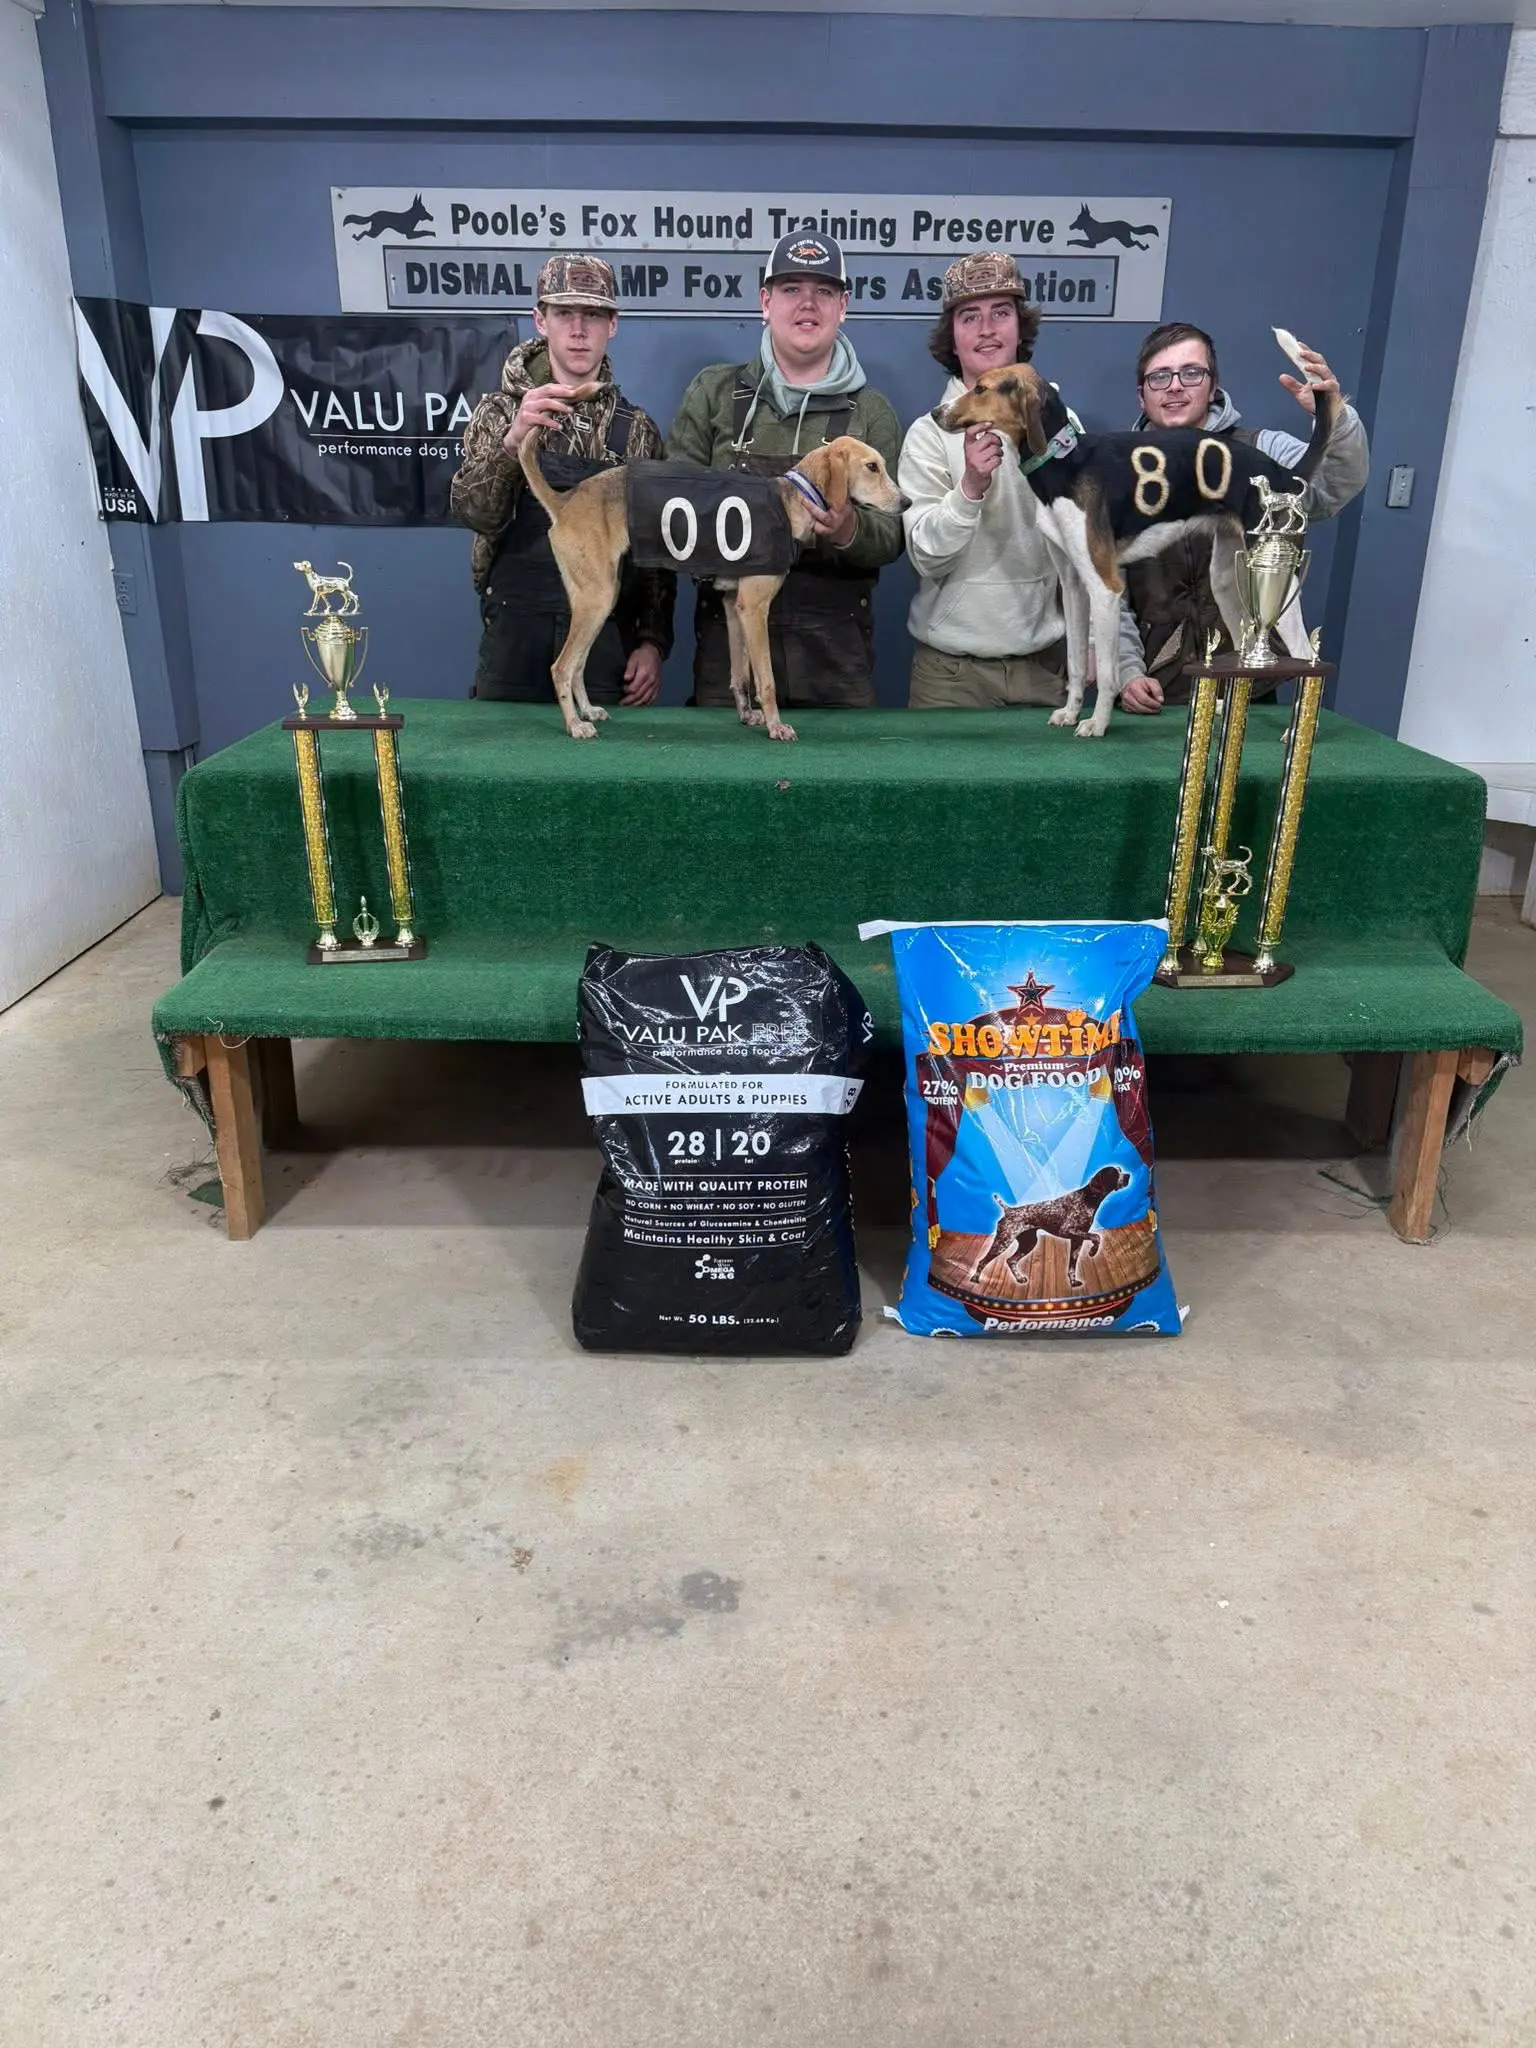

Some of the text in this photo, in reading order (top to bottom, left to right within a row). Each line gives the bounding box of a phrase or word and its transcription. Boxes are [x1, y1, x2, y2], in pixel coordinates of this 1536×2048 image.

[451, 203, 566, 237] Poole's
[582, 205, 637, 237] Fox
[654, 206, 753, 239] Hound
[913, 210, 1055, 243] Preserve
[406, 262, 532, 296] DISMAL
[684, 266, 742, 299] Fox
[73, 297, 285, 524] VP
[290, 389, 488, 432] VALU PA
[318, 442, 412, 458] performance
[419, 443, 448, 460] dog
[1131, 438, 1232, 516] 80
[105, 499, 137, 514] USA
[661, 496, 752, 562] 00
[680, 974, 749, 1023] VP
[622, 1023, 686, 1044] VALU
[697, 1024, 742, 1043] PAK
[653, 1045, 776, 1058] performance dog food
[1004, 1061, 1064, 1072] Premium
[1114, 1065, 1141, 1084] 0%
[666, 1081, 763, 1090] FORMULATED FOR
[923, 1080, 958, 1096] 27%
[970, 1067, 1101, 1092] DOG FOOD
[1117, 1083, 1131, 1093] FAT
[625, 1094, 808, 1106] ACTIVE ADULTS & PUPPIES
[667, 1130, 771, 1156] 28 20
[624, 1178, 808, 1192] MADE WITH QUALITY PROTEIN
[625, 1199, 807, 1211] NO CORN NO WHEAT NO SOY NO GLUTEN
[624, 1228, 806, 1247] Maintains Healthy Skin & Coat
[710, 1272, 735, 1280] 3&6
[689, 1314, 707, 1324] 50
[712, 1315, 740, 1325] LBS.
[984, 1315, 1115, 1332] Performance
